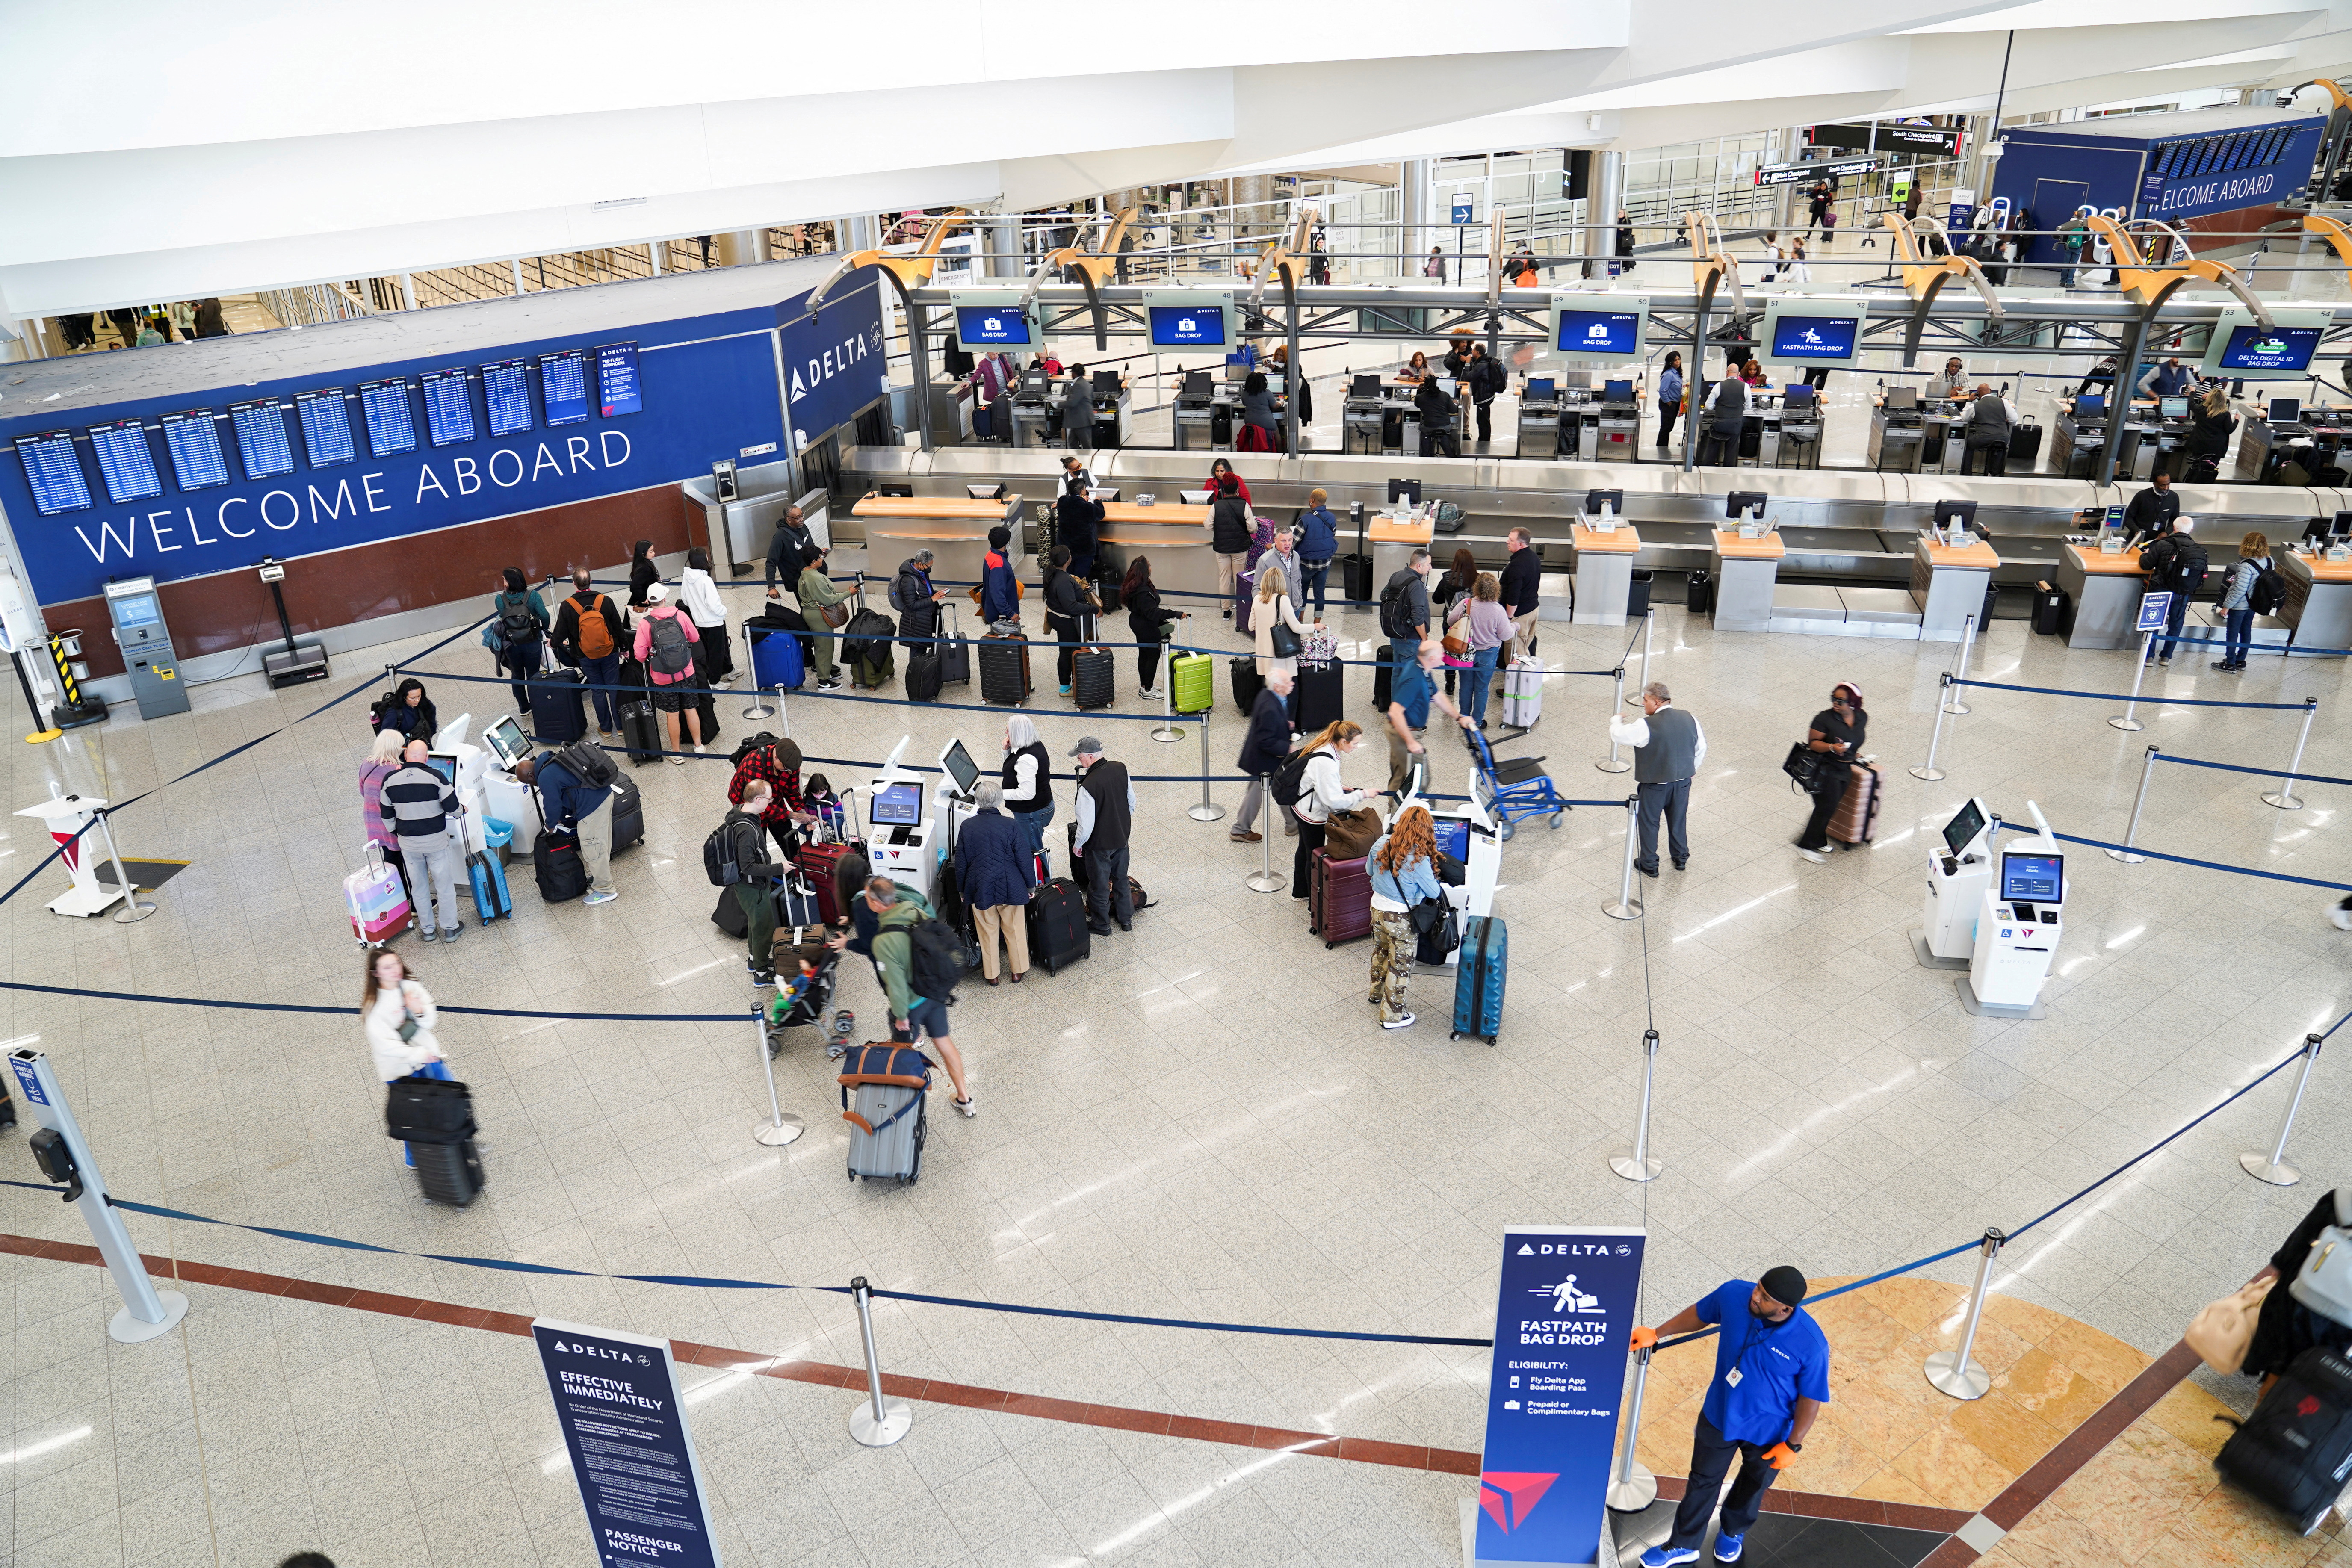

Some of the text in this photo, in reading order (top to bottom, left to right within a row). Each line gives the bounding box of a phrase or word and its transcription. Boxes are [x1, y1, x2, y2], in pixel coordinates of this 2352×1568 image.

[2219, 174, 2273, 201] ABOARD
[809, 333, 867, 388] DELTA
[74, 472, 391, 564] WELCOME
[416, 430, 631, 504] ABOARD
[115, 582, 149, 590] readySTATION
[7, 606, 23, 615] CLEAR
[13, 1065, 34, 1075] SANITIZE
[18, 1071, 34, 1079] HANDS
[1540, 1244, 1609, 1255] DELTA
[1520, 1320, 1607, 1333] FASTPATH
[1520, 1333, 1604, 1346] BAG DROP
[572, 1344, 632, 1363] DELTA
[1775, 1349, 1790, 1360] DELTA
[1509, 1361, 1568, 1369] ELIGIBILITY:
[560, 1370, 633, 1393] EFFECTIVE
[1530, 1384, 1566, 1392] Boarding
[564, 1383, 662, 1410] IMMEDIATELY
[570, 1407, 599, 1415] Transportation
[616, 1416, 644, 1424] Administration
[1527, 1408, 1589, 1416] Complimentary
[603, 1423, 628, 1432] RESTRICTIONS
[605, 1528, 683, 1553] PASSENGER
[608, 1539, 659, 1557] NOTICE
